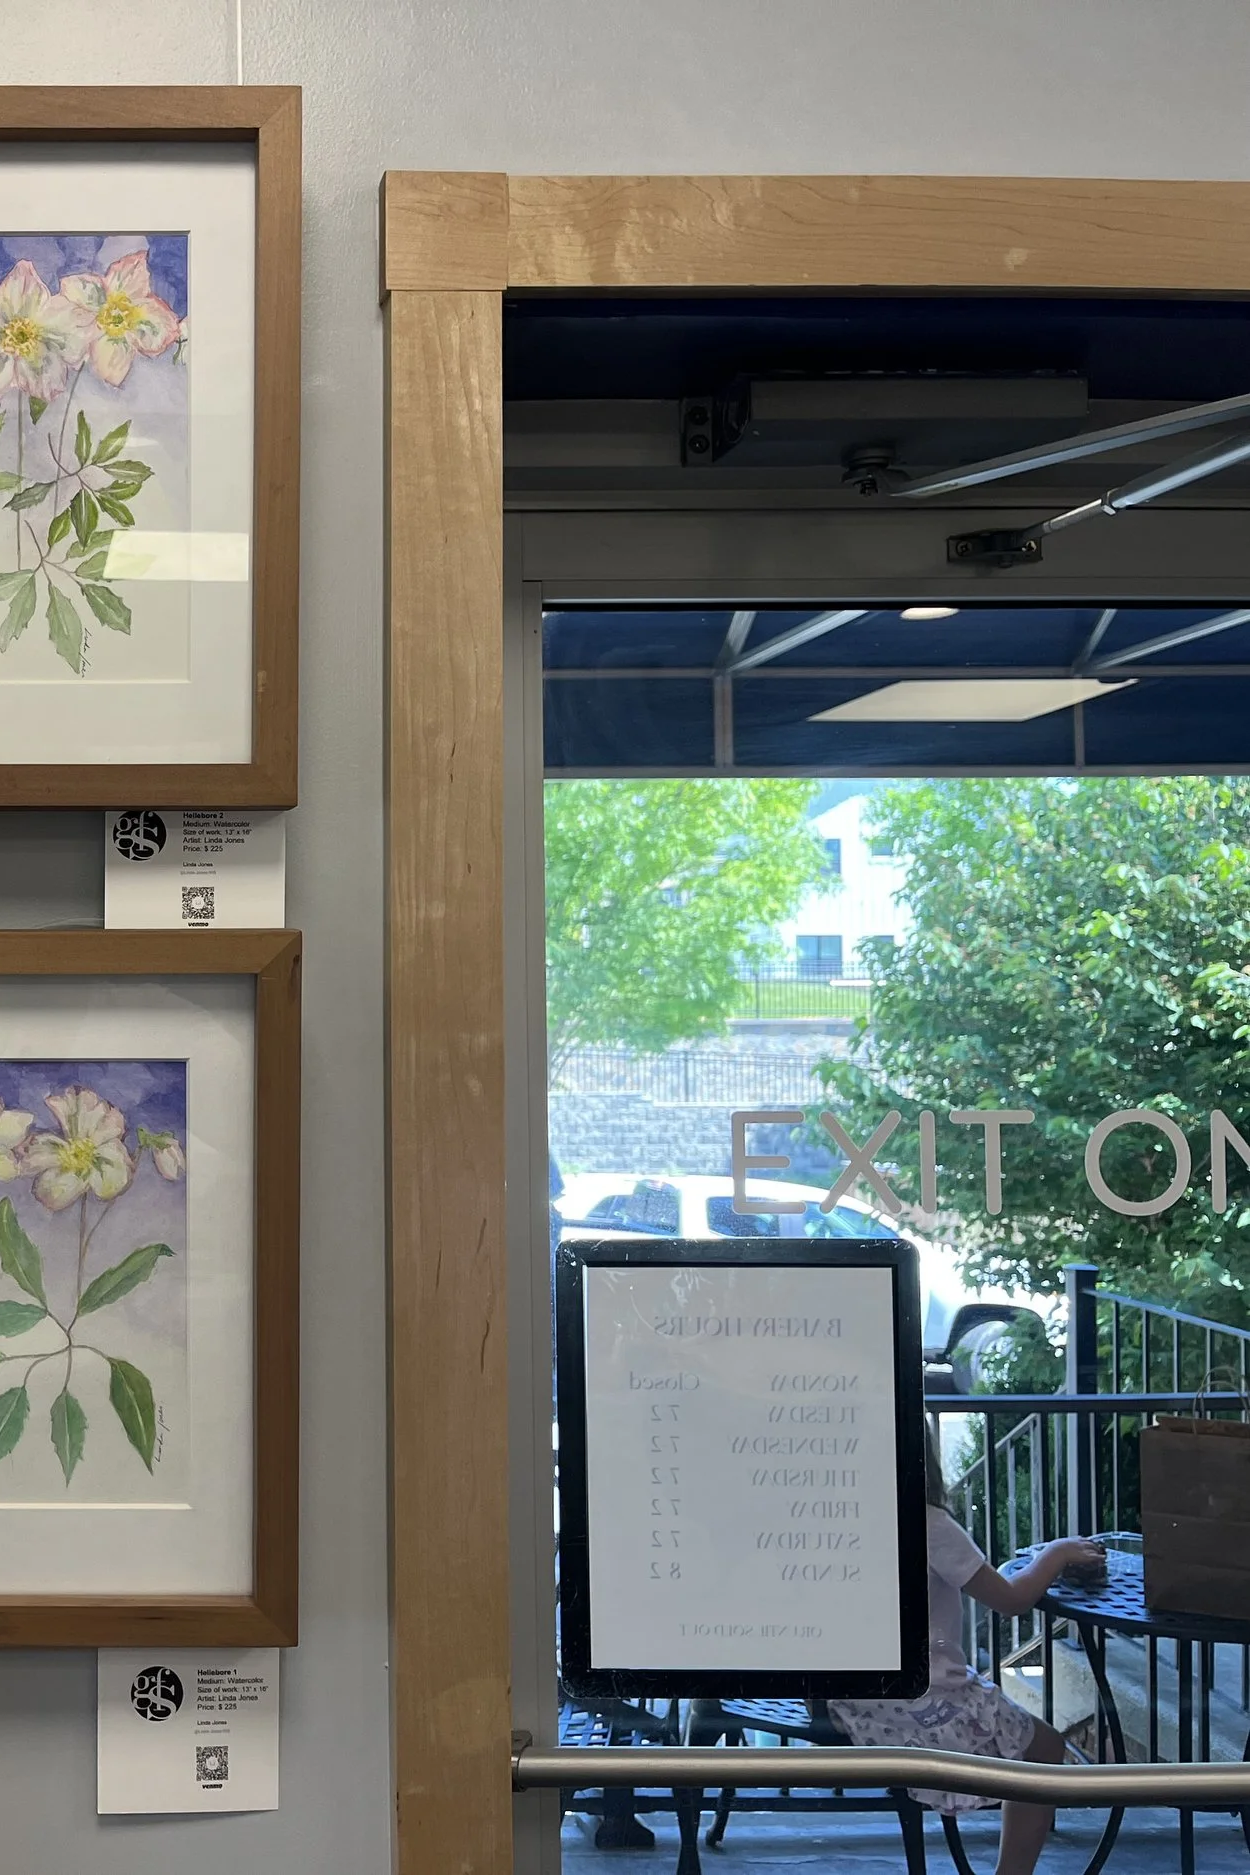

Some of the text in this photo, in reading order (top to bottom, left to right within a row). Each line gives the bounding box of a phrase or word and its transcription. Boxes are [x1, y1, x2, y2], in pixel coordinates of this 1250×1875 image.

[183, 820, 250, 828] Medium: Watercolor
[731, 1109, 1035, 1215] EXIT
